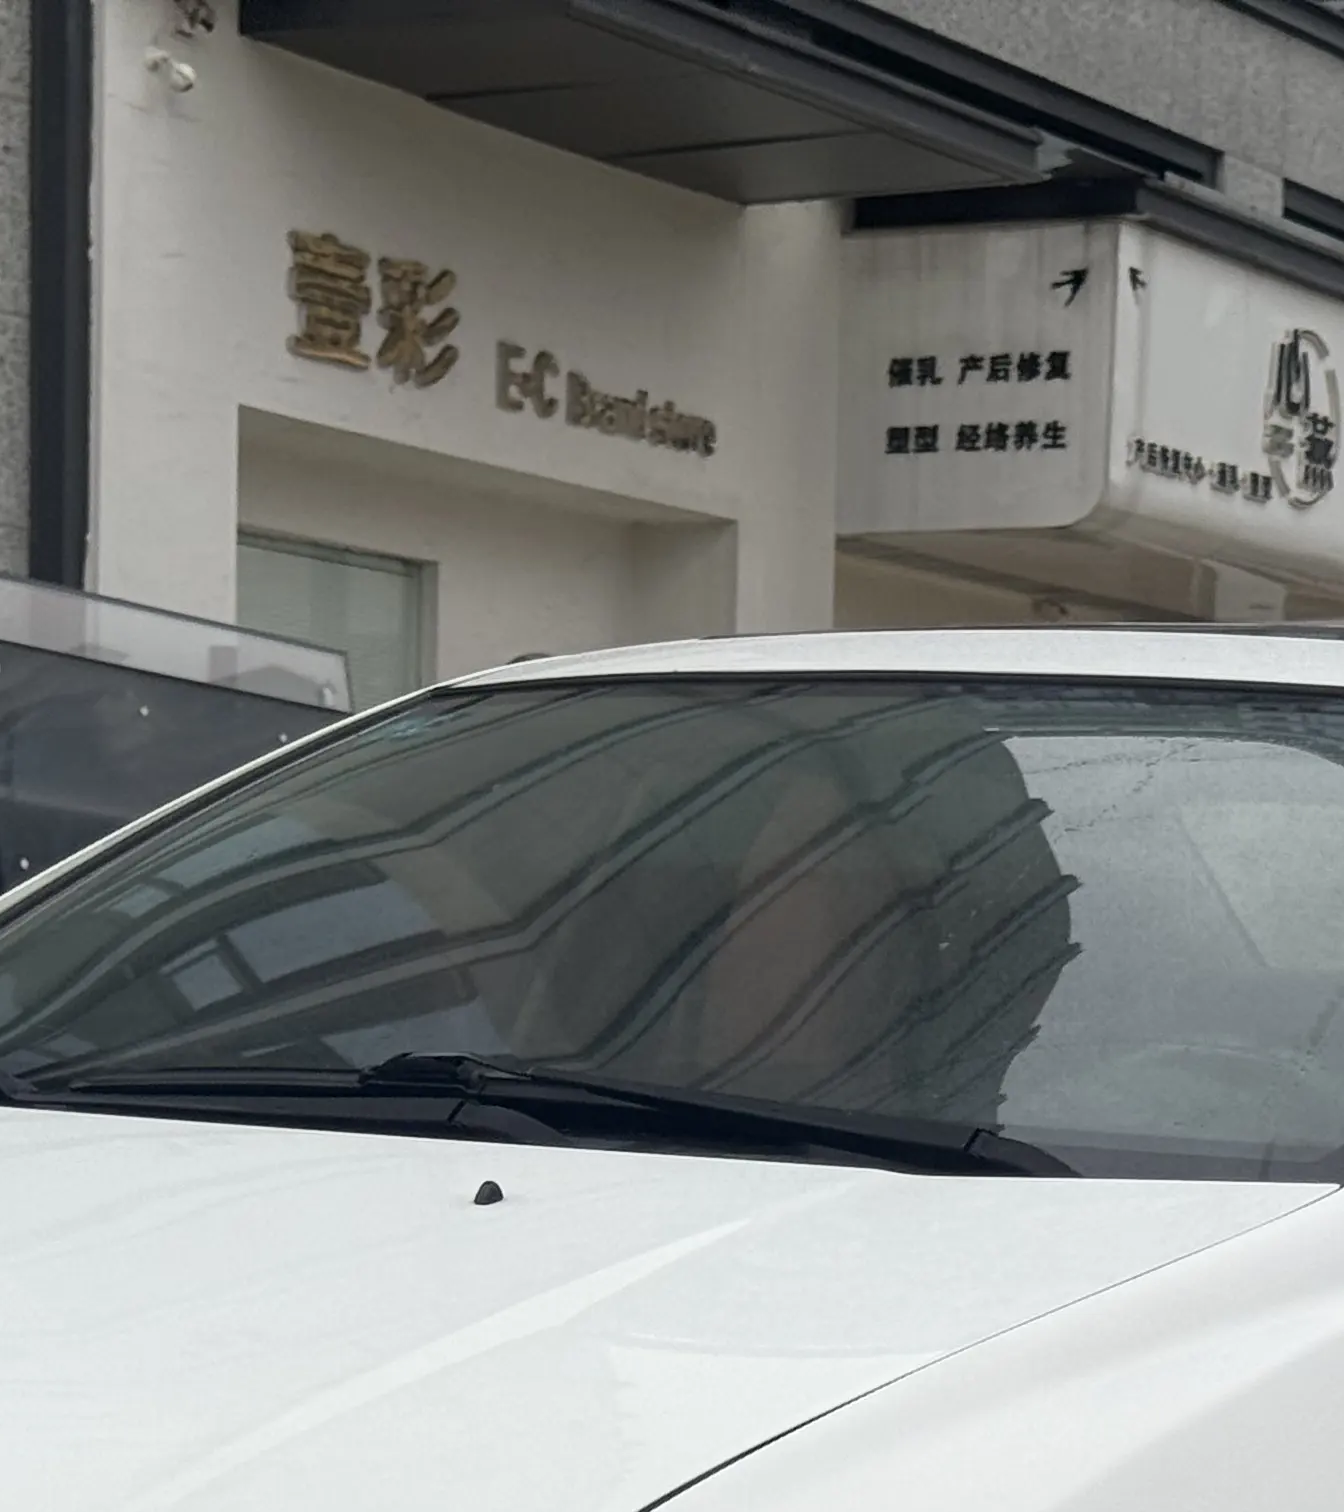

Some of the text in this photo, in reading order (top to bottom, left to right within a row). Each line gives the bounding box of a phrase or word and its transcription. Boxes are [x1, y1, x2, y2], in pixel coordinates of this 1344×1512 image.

[286, 230, 460, 389] 壹彩
[958, 350, 1071, 385] 产后修复
